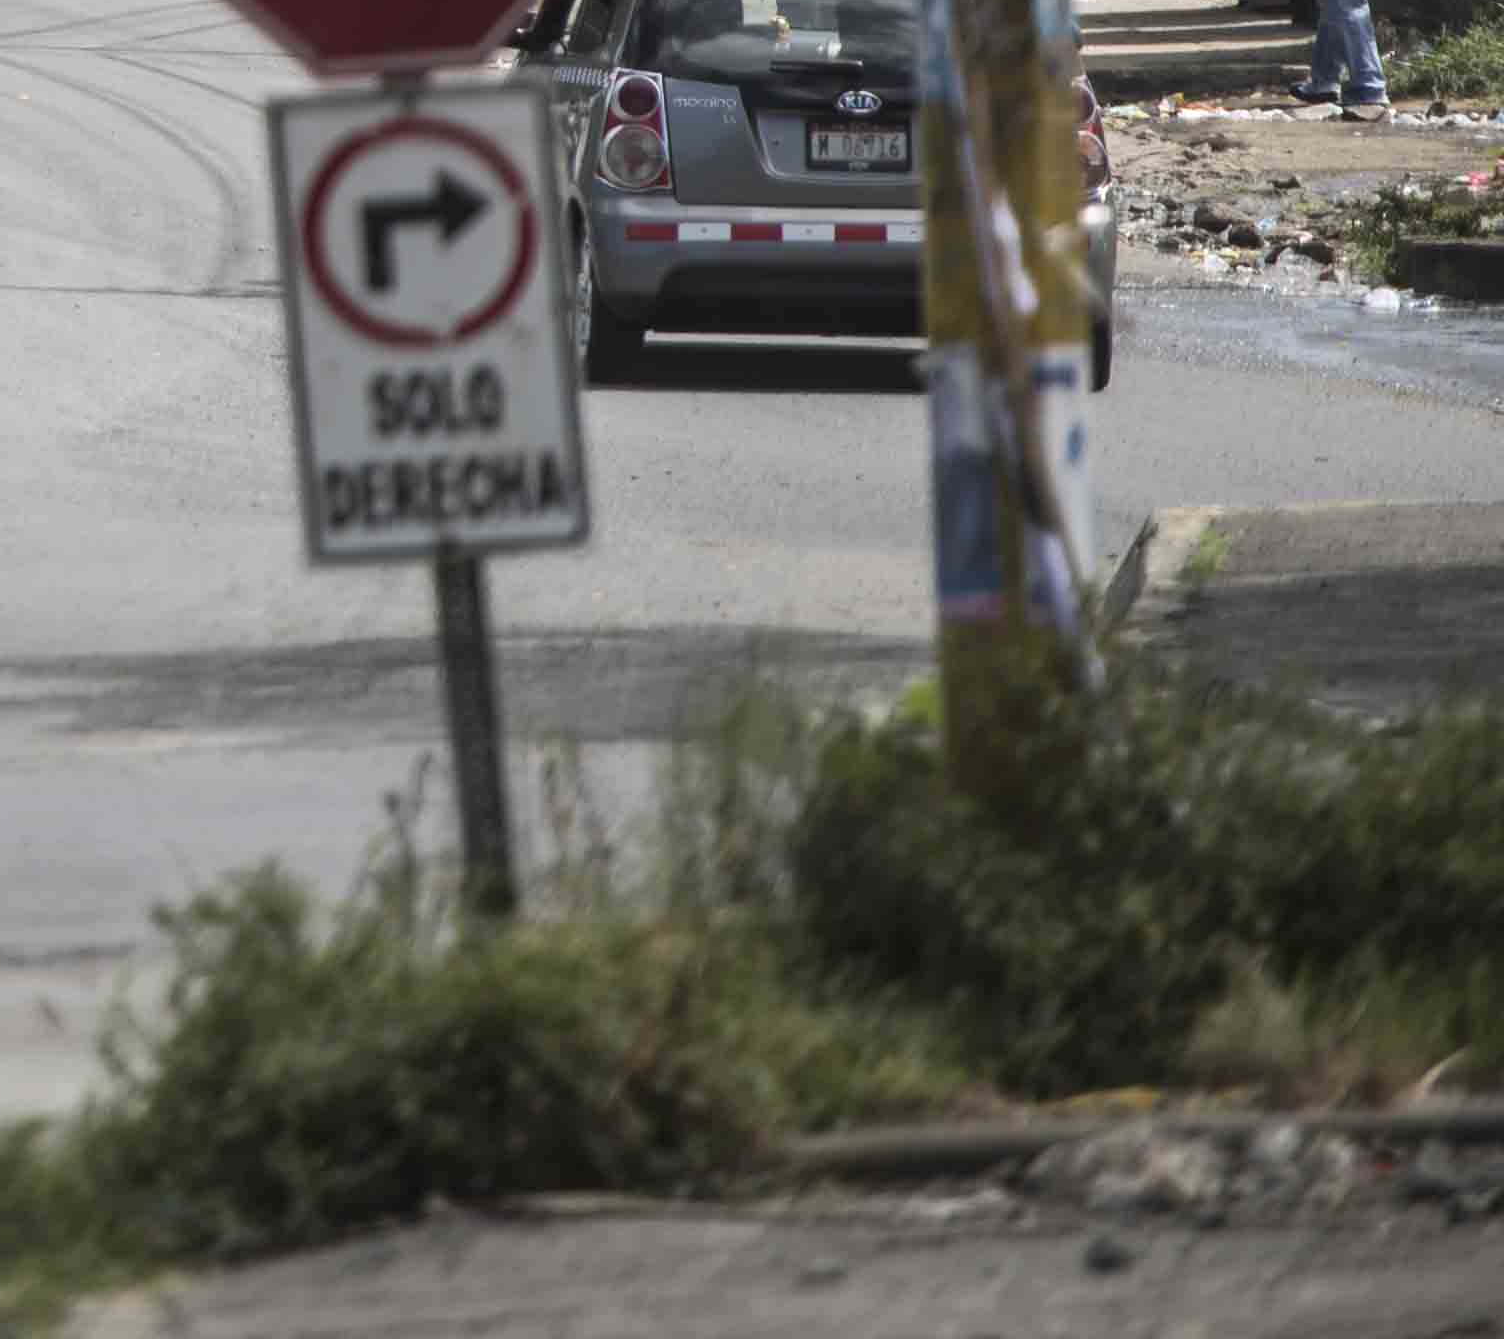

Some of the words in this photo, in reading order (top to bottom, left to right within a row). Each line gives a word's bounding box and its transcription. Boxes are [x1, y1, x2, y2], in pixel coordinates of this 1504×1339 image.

[842, 96, 876, 109] KIA
[369, 364, 509, 440] SOLO
[323, 447, 564, 529] DERECHA
